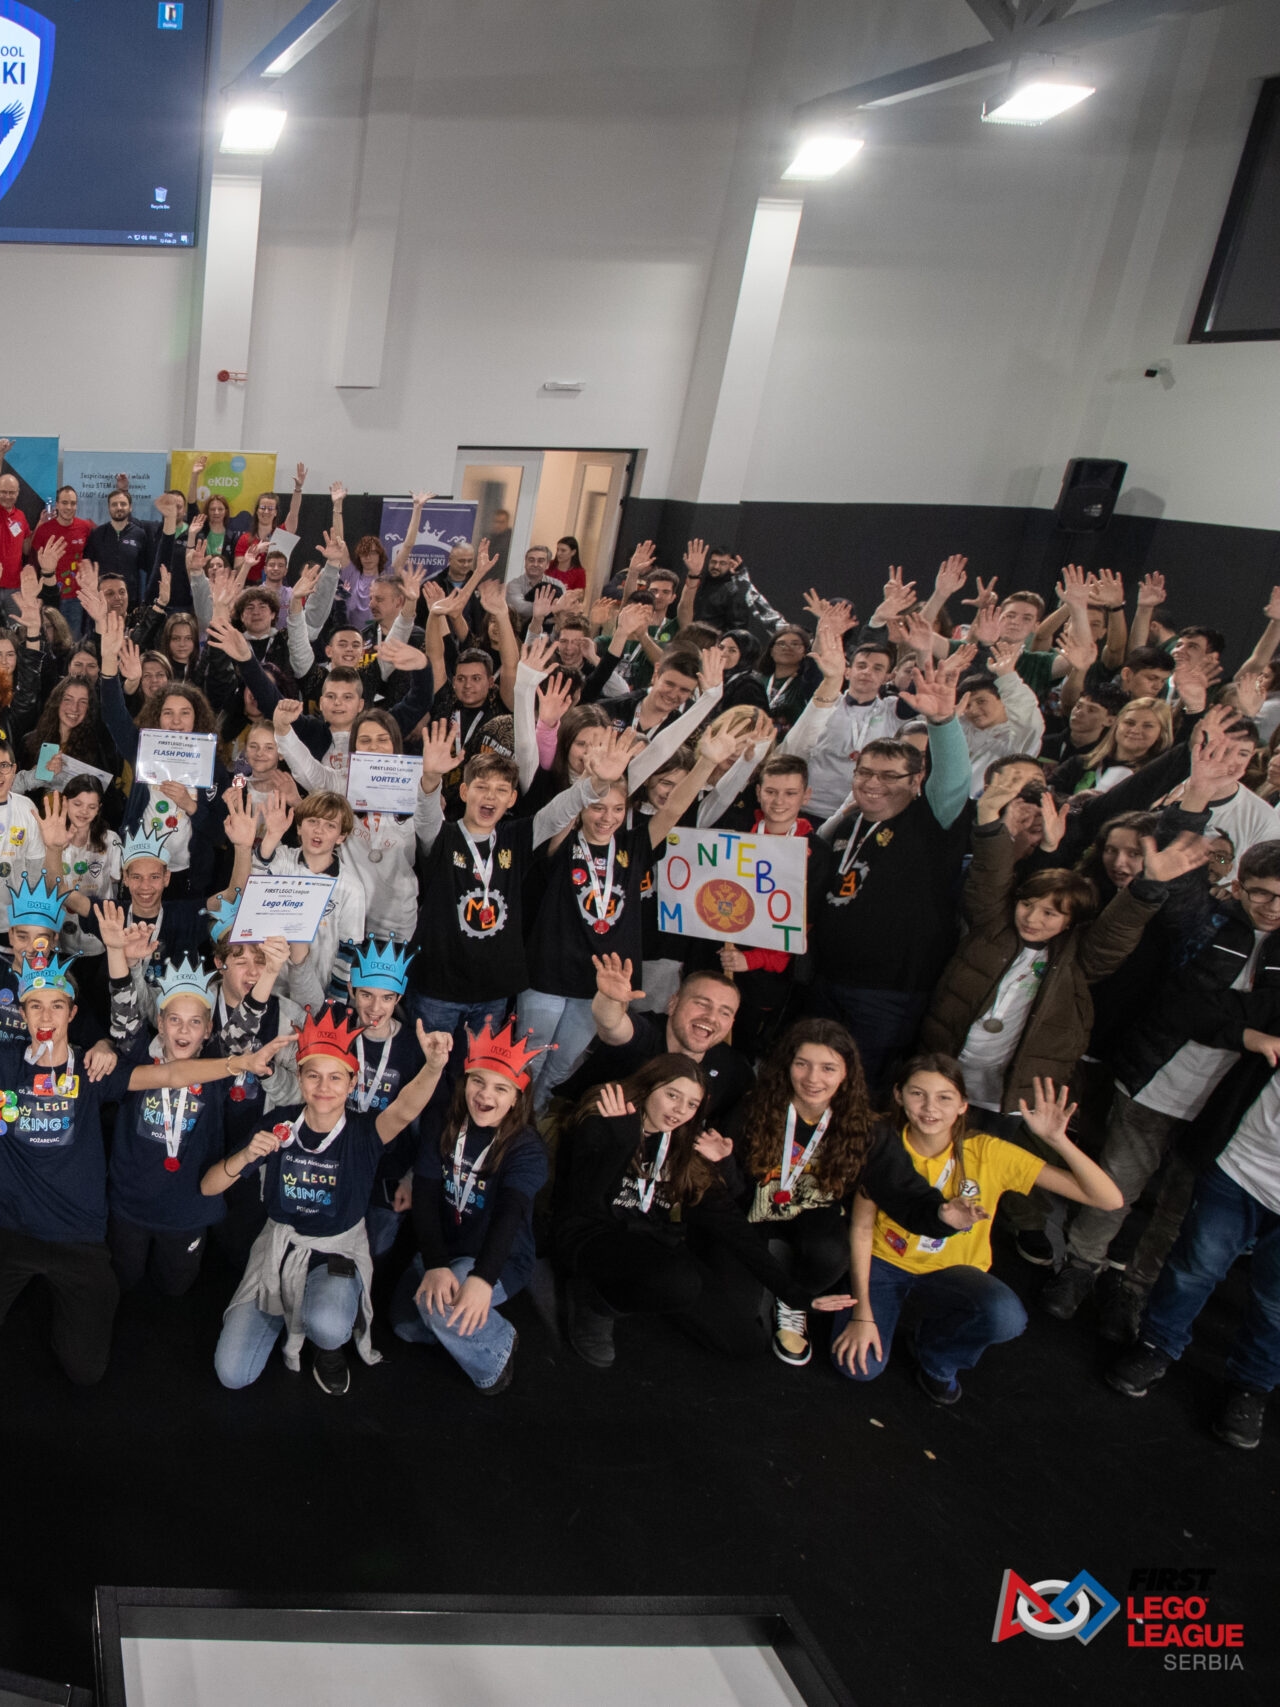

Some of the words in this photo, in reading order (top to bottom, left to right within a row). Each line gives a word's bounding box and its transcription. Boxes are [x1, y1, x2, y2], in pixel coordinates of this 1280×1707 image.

[207, 475, 240, 488] eKIDS
[153, 749, 176, 757] FLASH
[262, 900, 280, 908] Lego
[282, 900, 304, 908] Kings
[6, 1017, 27, 1030] LEG
[36, 1101, 69, 1111] LEGO
[19, 1116, 70, 1131] KINGS
[302, 1171, 336, 1186] LEGO
